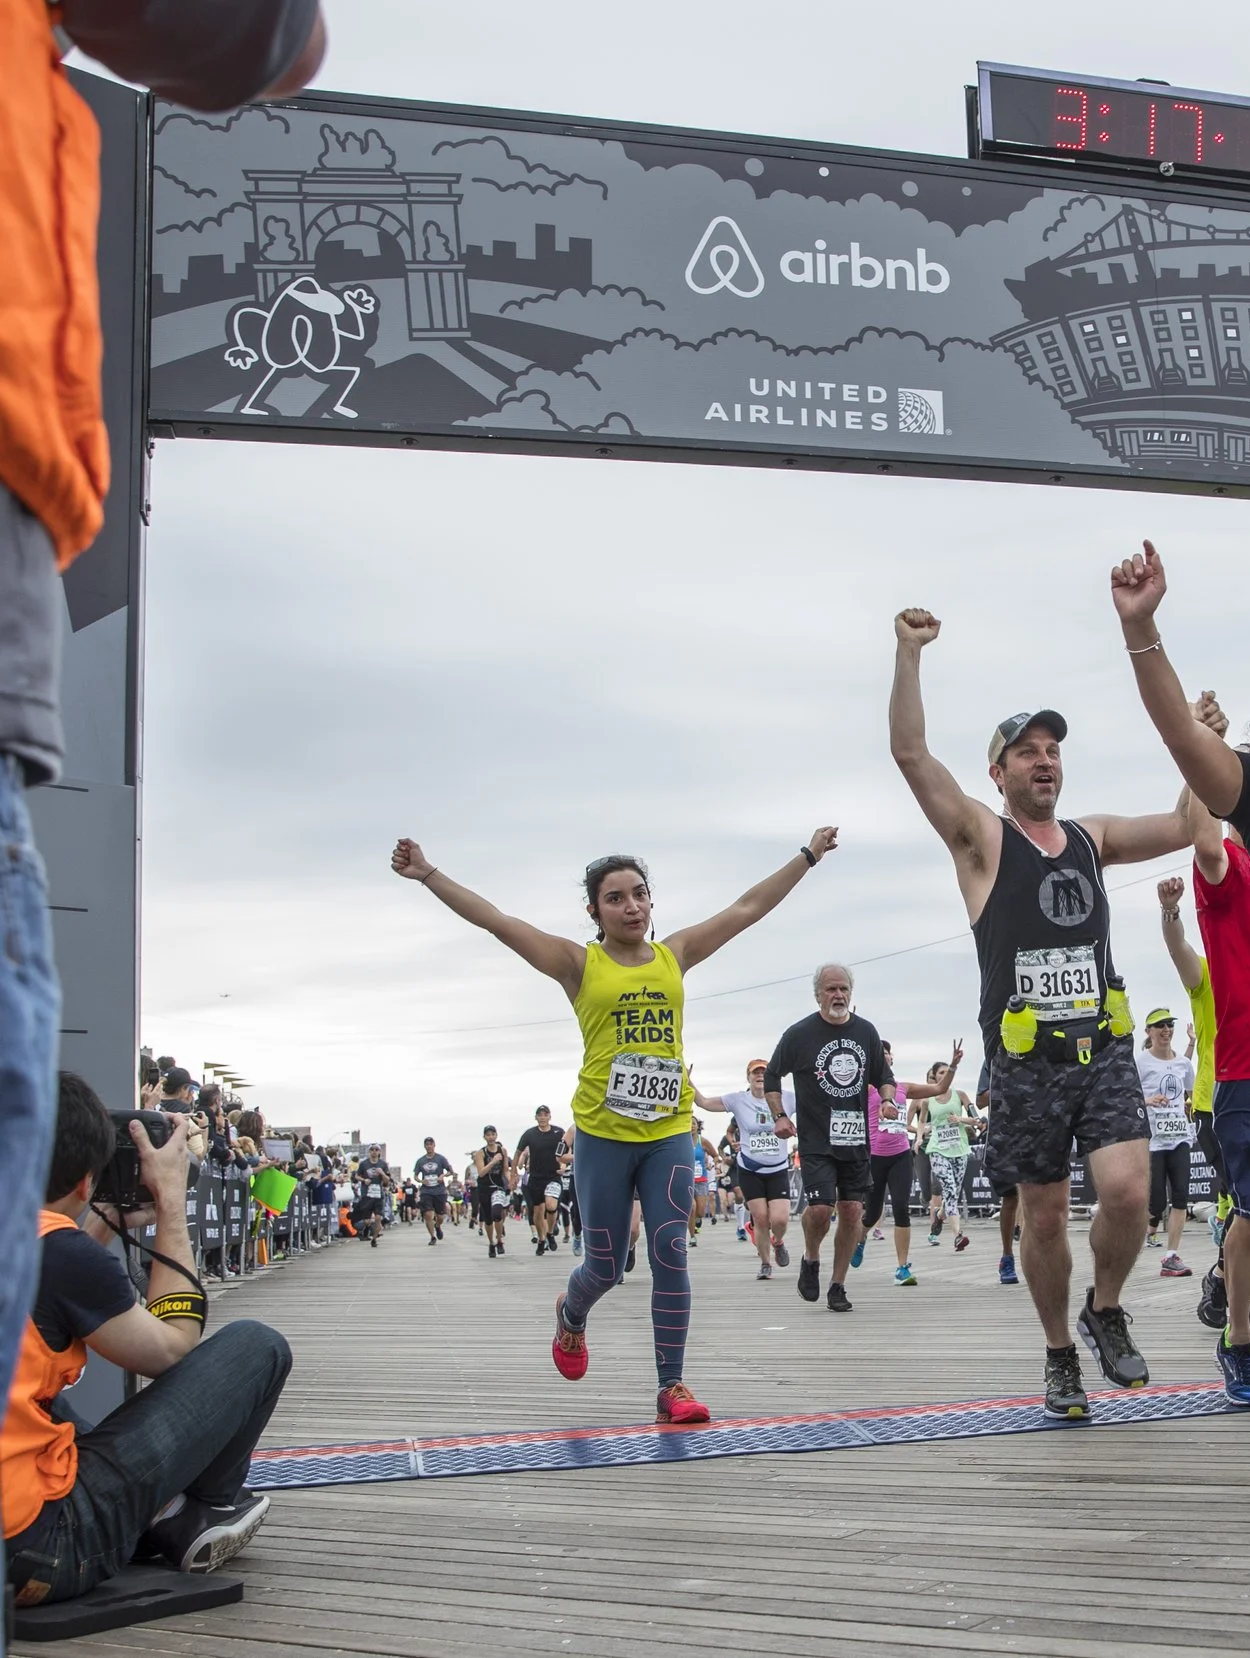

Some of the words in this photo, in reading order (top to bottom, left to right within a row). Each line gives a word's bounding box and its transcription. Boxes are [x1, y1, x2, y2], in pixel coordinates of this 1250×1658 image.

[779, 238, 951, 295] airbnb
[749, 377, 888, 404] UNITED
[703, 402, 889, 432] AIRLINES
[1020, 975, 1034, 994] D
[1040, 968, 1095, 998] 31631
[611, 1009, 674, 1026] TEAM
[624, 1026, 675, 1044] KIDS
[815, 1040, 839, 1068] CONEY
[841, 1039, 867, 1065] ISLAND
[613, 1072, 626, 1090] F
[627, 1073, 679, 1102] 31836
[831, 1122, 838, 1132] C
[1157, 1121, 1163, 1130] C
[1164, 1120, 1187, 1132] 29502
[1190, 1151, 1207, 1164] TATA
[151, 1300, 192, 1316] Nikon
